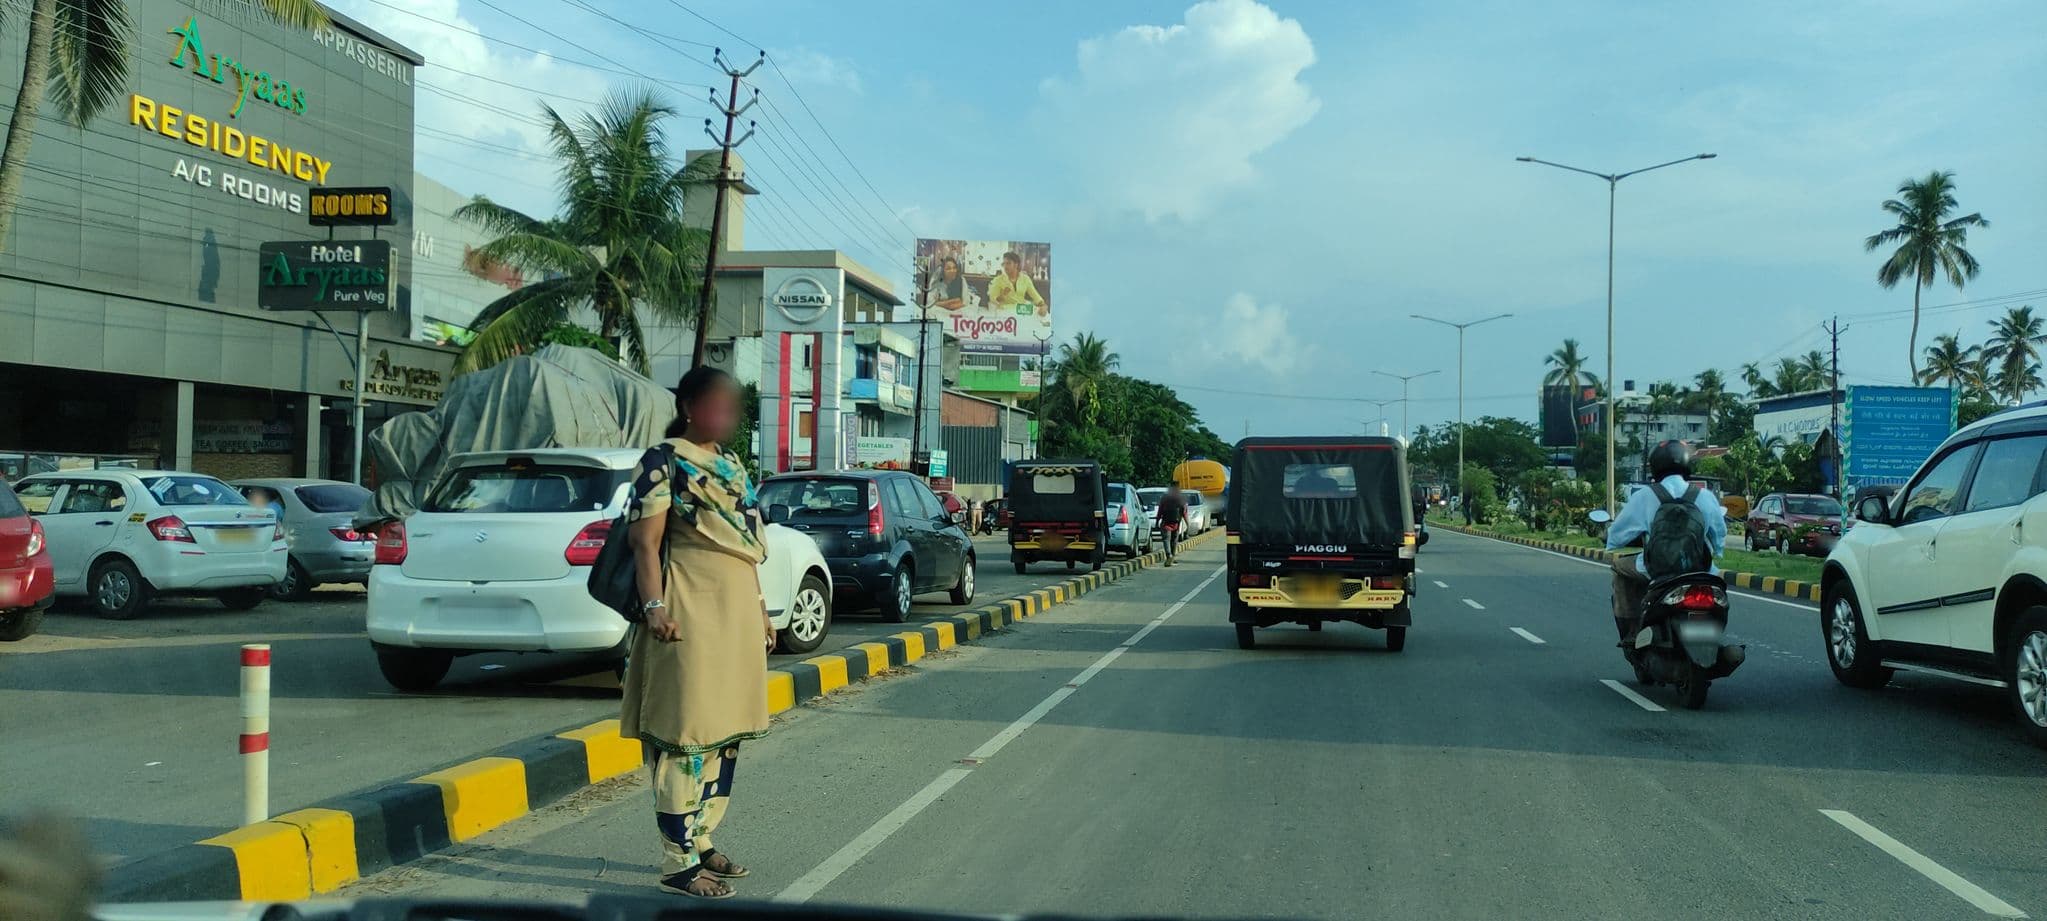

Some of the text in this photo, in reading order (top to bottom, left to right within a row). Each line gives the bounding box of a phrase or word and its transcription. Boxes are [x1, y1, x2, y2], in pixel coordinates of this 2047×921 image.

[166, 15, 307, 118] Aryaas
[312, 26, 411, 87] APPASSERIL
[130, 94, 331, 185] RESIDENCY
[171, 159, 302, 213] A/C ROOMS
[311, 194, 388, 216] ROOMS
[310, 245, 361, 263] Hotel
[263, 252, 385, 301] Aryaas
[334, 290, 385, 303] Pure Veg
[778, 295, 825, 304] NISSAN
[1295, 544, 1347, 553] PIAGGIO
